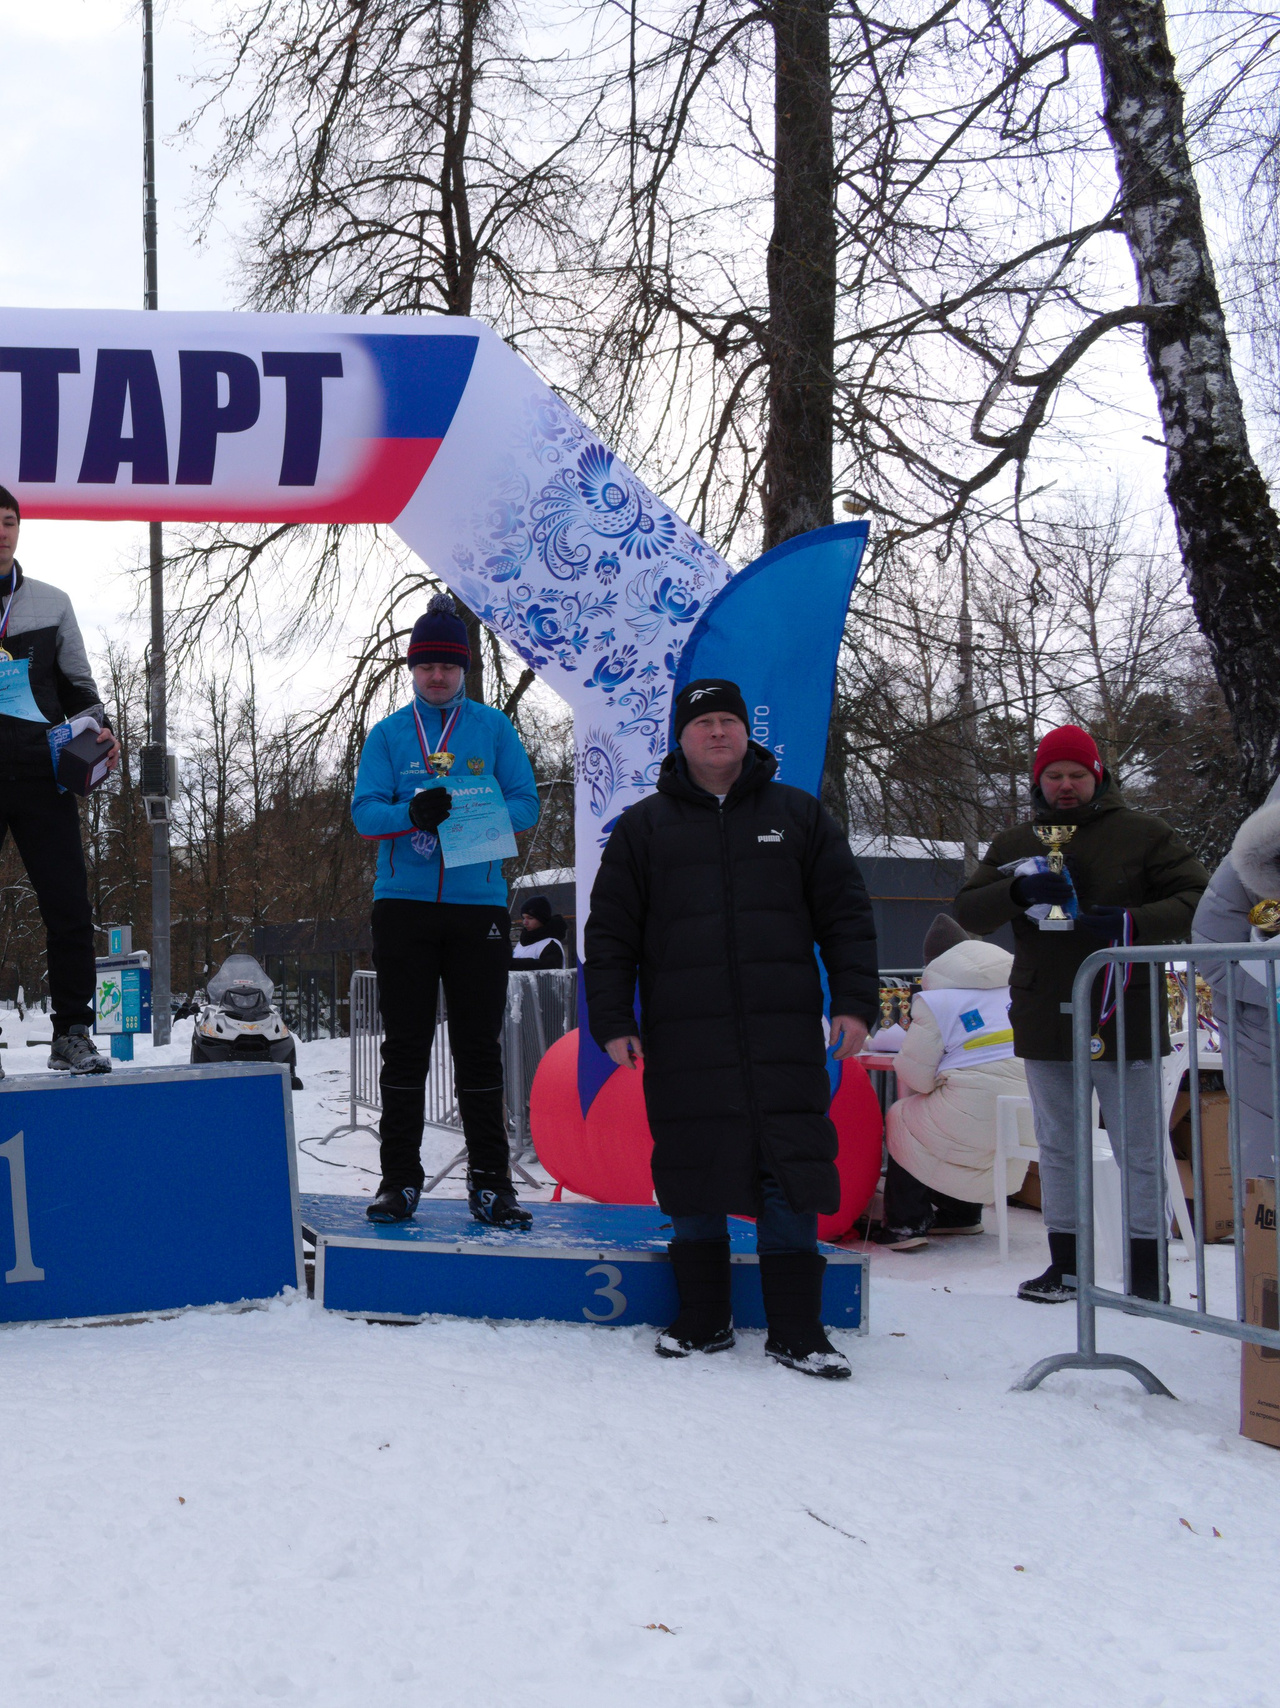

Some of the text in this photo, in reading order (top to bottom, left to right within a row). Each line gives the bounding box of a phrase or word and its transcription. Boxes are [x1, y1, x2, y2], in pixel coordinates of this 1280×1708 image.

[449, 786, 493, 797] АМОТА
[757, 835, 781, 843] PUMA
[582, 1263, 628, 1322] 3
